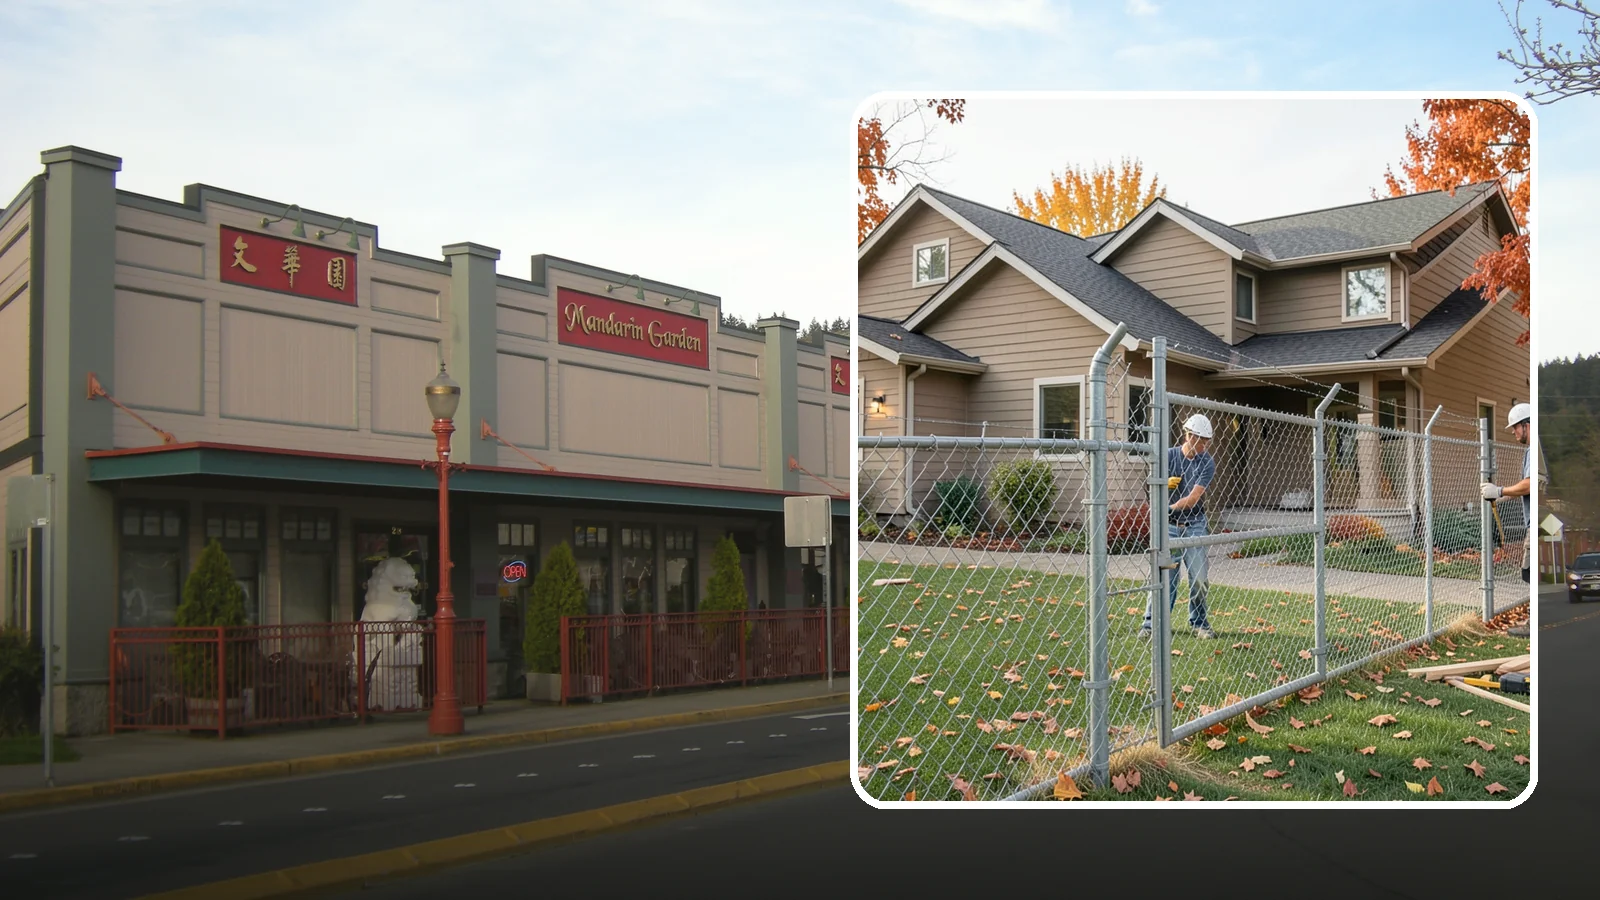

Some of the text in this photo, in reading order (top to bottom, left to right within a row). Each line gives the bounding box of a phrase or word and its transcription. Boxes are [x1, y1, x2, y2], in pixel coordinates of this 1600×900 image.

[230, 235, 347, 291] 文華園
[564, 302, 701, 352] Mandarin Garden
[503, 565, 527, 578] OPEN
